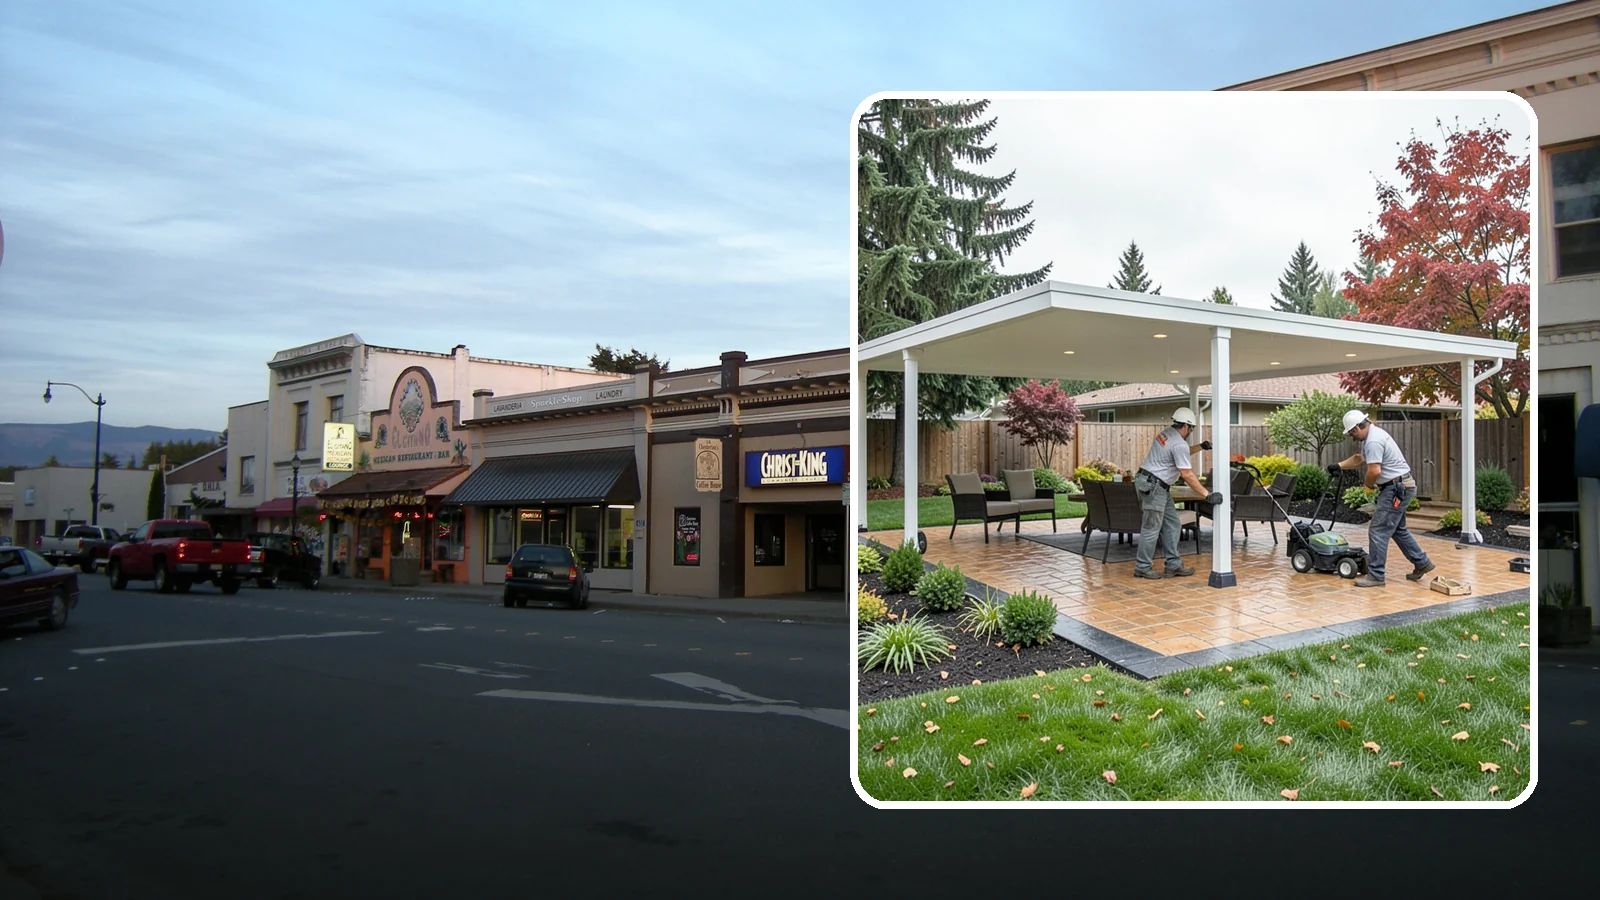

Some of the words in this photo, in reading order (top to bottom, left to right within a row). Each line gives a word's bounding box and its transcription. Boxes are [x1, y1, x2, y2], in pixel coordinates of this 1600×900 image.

[561, 394, 582, 404] Shop
[596, 388, 623, 400] LAUNDRY
[493, 402, 523, 412] LAVANDERIA
[374, 455, 396, 464] MEXICAN
[398, 452, 433, 462] RESTAURANT
[438, 450, 450, 458] BAR
[760, 452, 798, 478] CHRIST
[799, 450, 827, 476] KING
